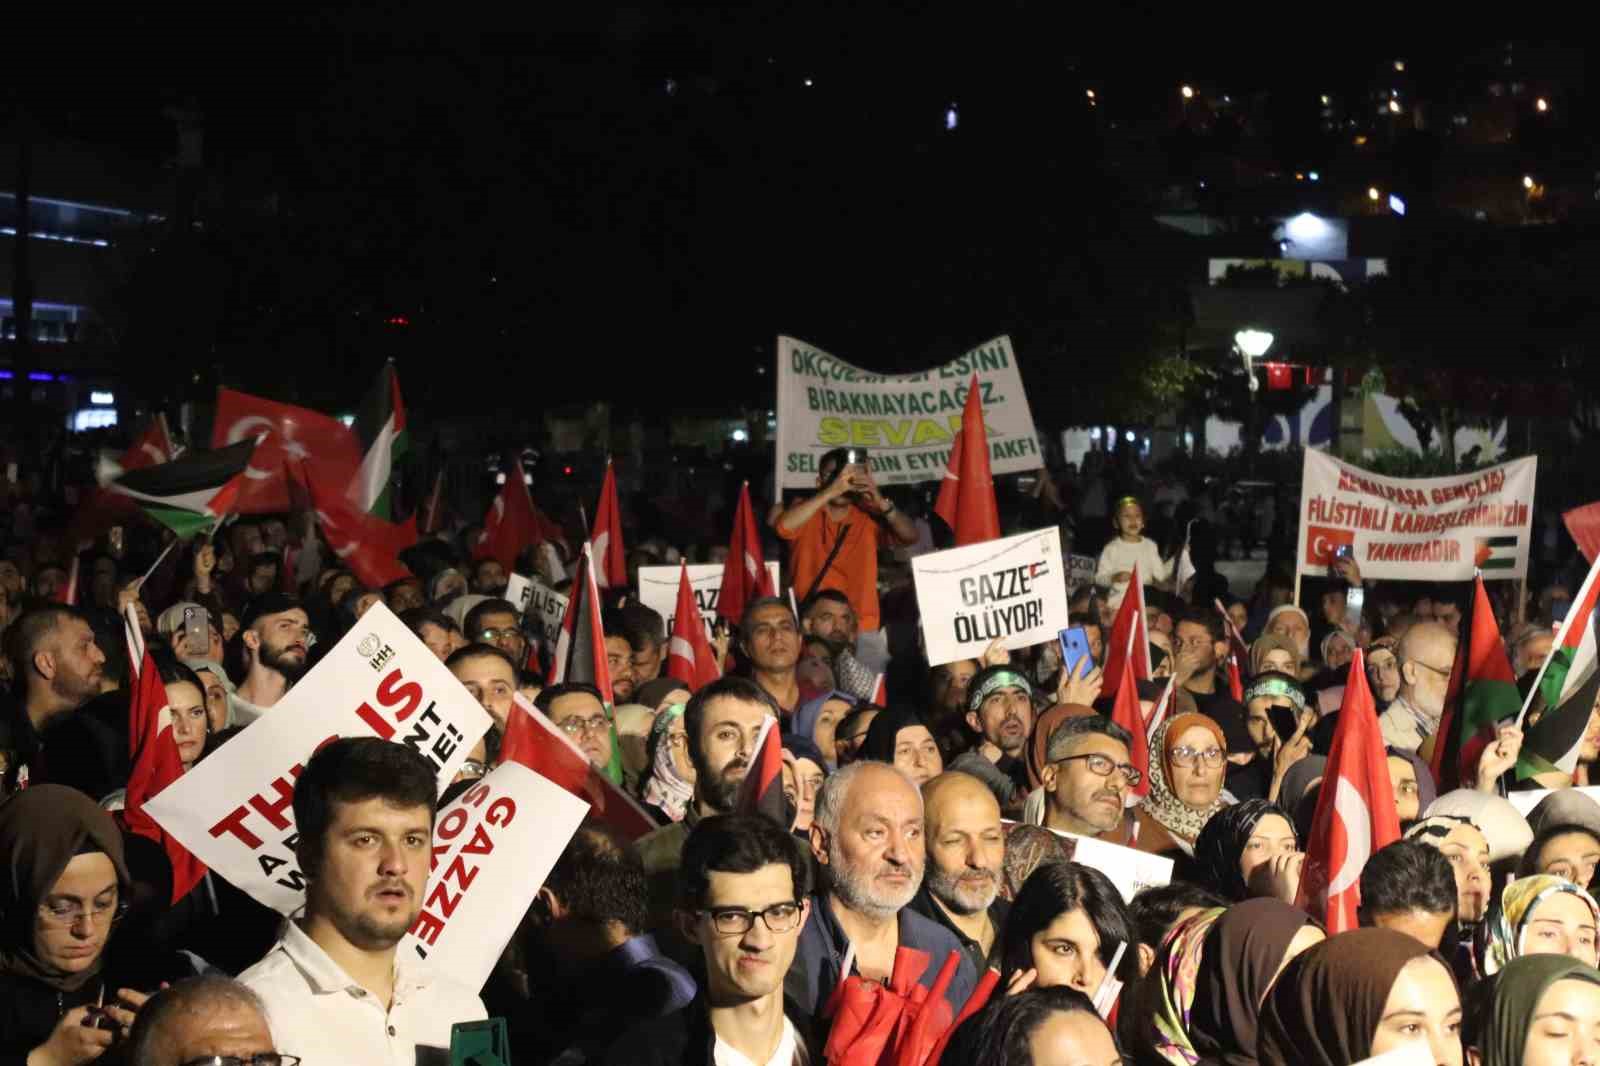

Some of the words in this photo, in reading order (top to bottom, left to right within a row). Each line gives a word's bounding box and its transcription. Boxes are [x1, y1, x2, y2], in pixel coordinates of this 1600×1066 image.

[807, 382, 1004, 416] BIRAKMAYACAĞZ.
[993, 438, 1037, 460] AKFI
[1308, 495, 1388, 531] FİLİSTİNLİ
[959, 564, 1033, 608] GAZZE
[954, 598, 1044, 643] ÖLÜYOR!
[355, 668, 424, 741] IS
[430, 783, 490, 873] SOY
